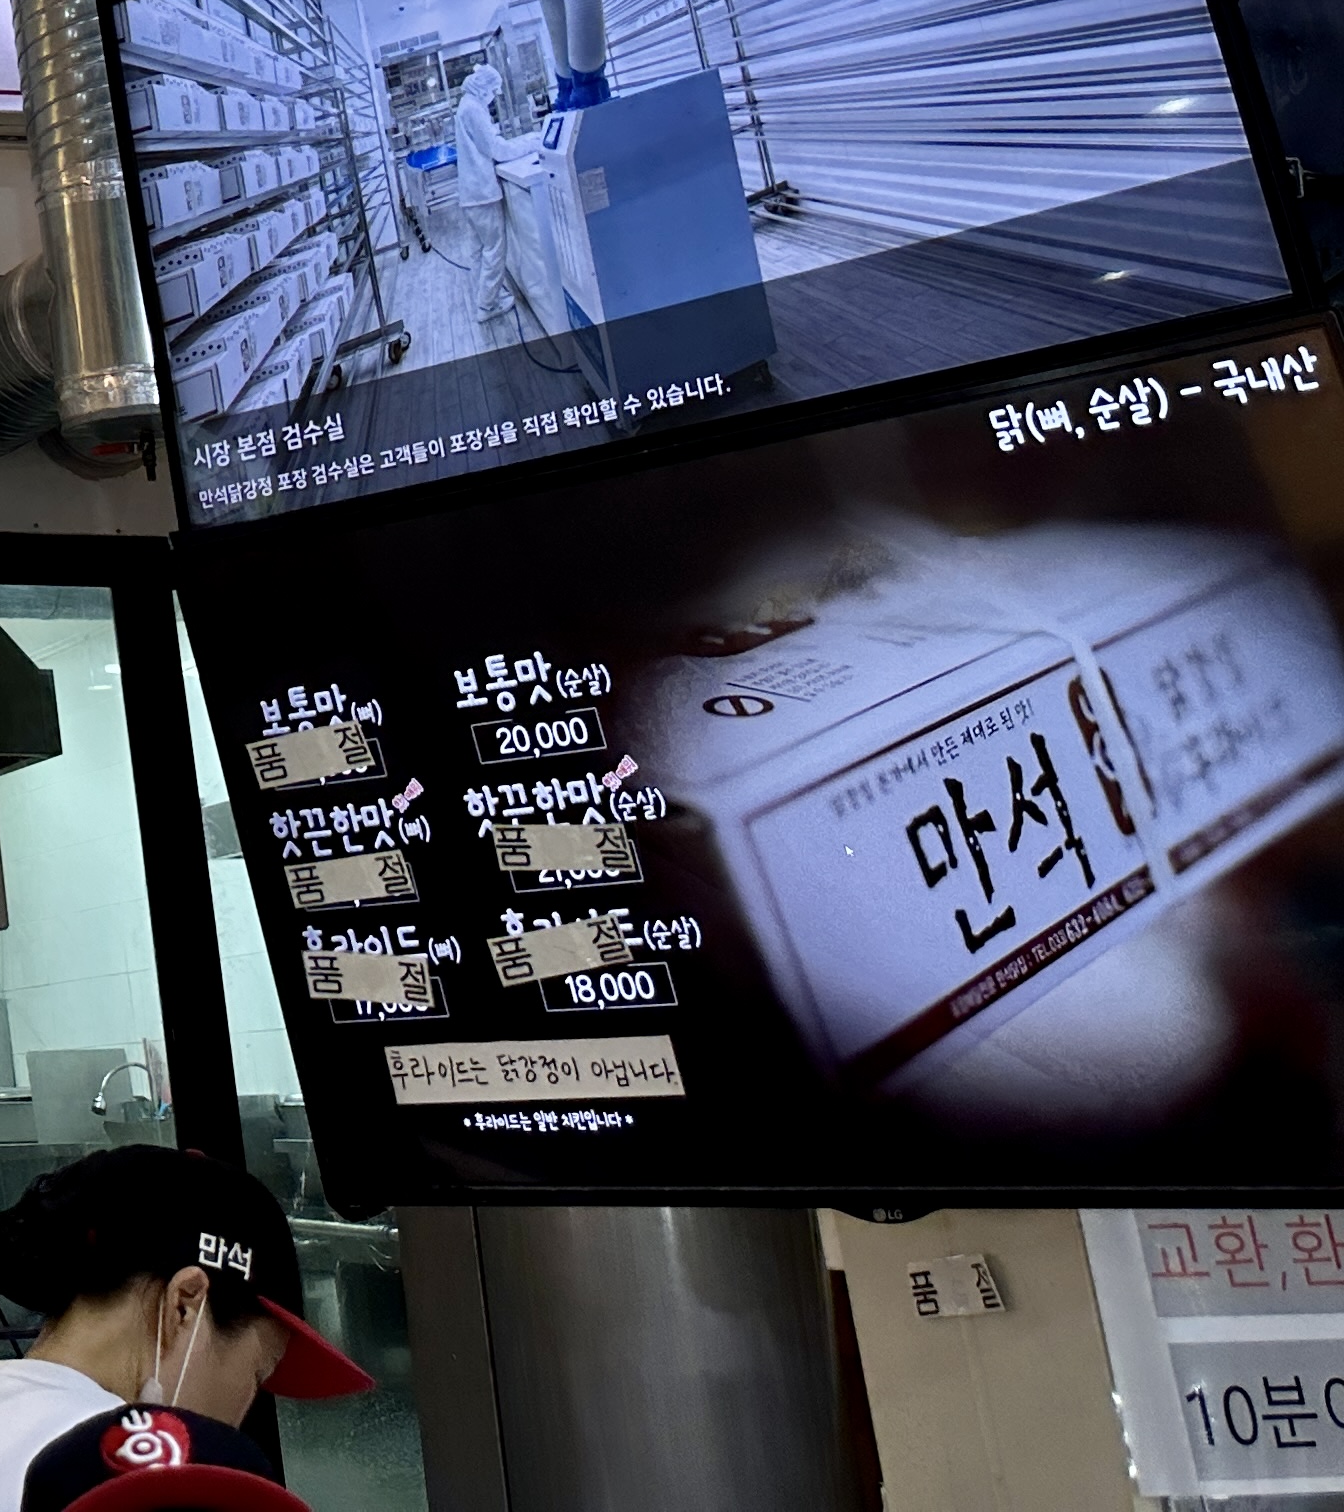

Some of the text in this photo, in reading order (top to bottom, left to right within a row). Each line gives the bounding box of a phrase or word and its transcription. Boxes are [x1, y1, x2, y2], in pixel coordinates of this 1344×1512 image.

[988, 400, 1085, 452] 닭(뼈,
[1089, 377, 1169, 431] 순살)
[1212, 345, 1320, 405] 국내산
[193, 412, 345, 469] 시장 본점 검수실
[198, 373, 731, 510] 만석닭강정 포장 검수실은 고객들이 포장실을 직접 확인할 수 있습니다.
[495, 717, 588, 758] 20,000
[905, 731, 1096, 954] 만석
[564, 970, 655, 1010] 18,000
[391, 1050, 489, 1089] 후라이드는
[496, 1054, 580, 1084] 닭강정이
[474, 1109, 623, 1132] 후라이드는 일반 치킨입니다
[887, 1209, 903, 1220] LG
[198, 1232, 253, 1281] 만석
[909, 1270, 940, 1317] 품
